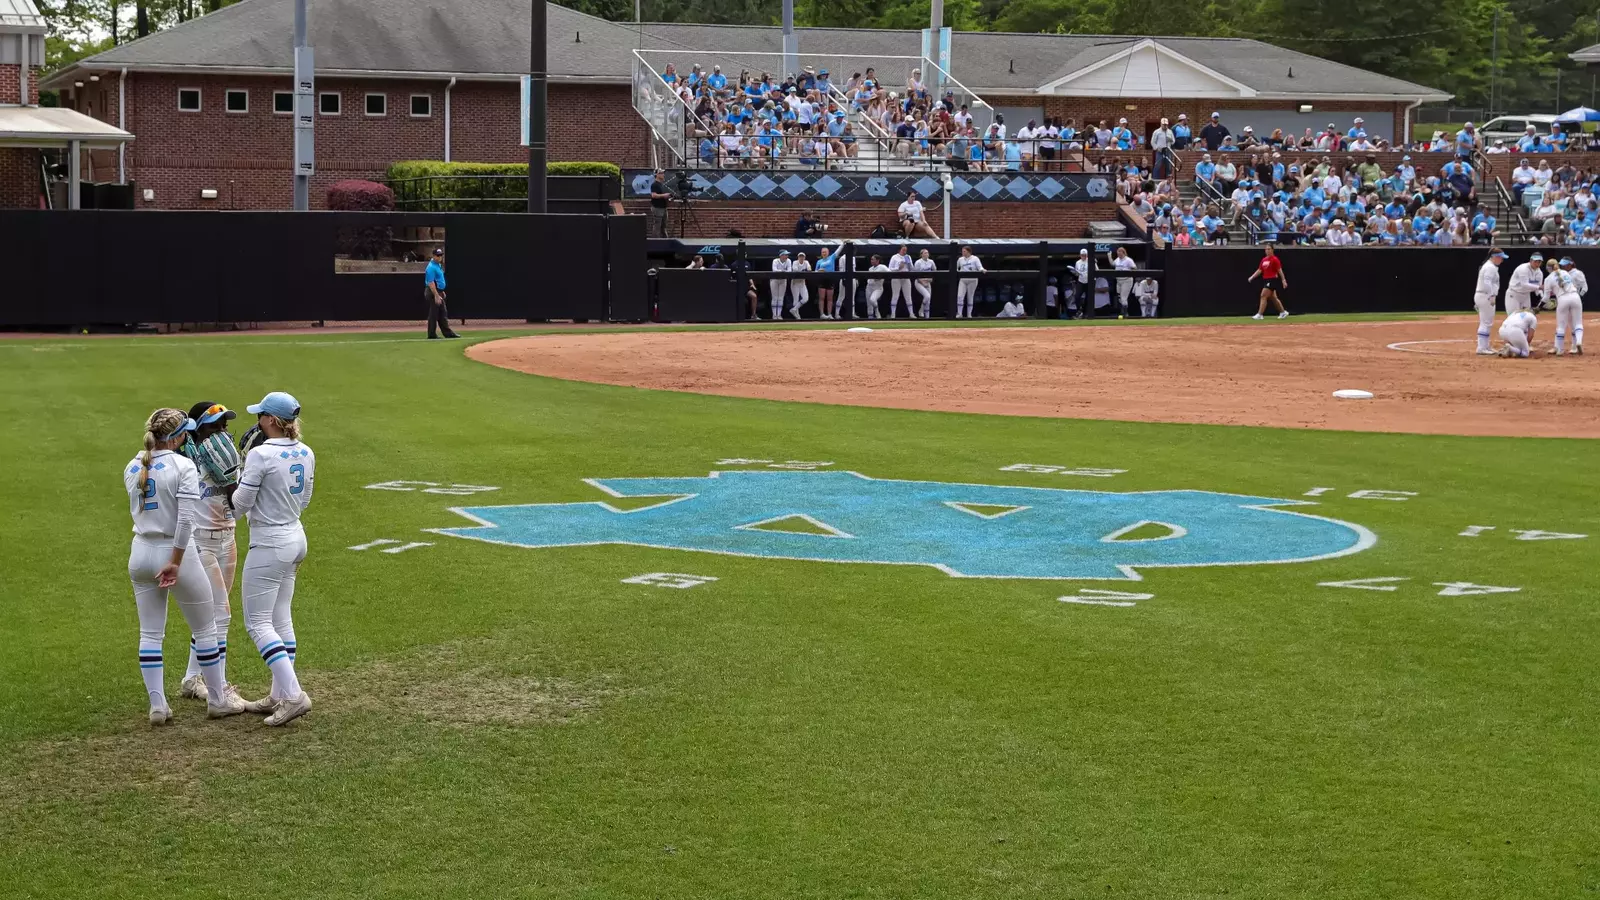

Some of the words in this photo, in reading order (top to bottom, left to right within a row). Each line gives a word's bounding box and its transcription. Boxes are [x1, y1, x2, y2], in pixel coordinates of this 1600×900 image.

[697, 245, 721, 254] ACC
[138, 477, 158, 510] 2
[289, 464, 304, 494] 3
